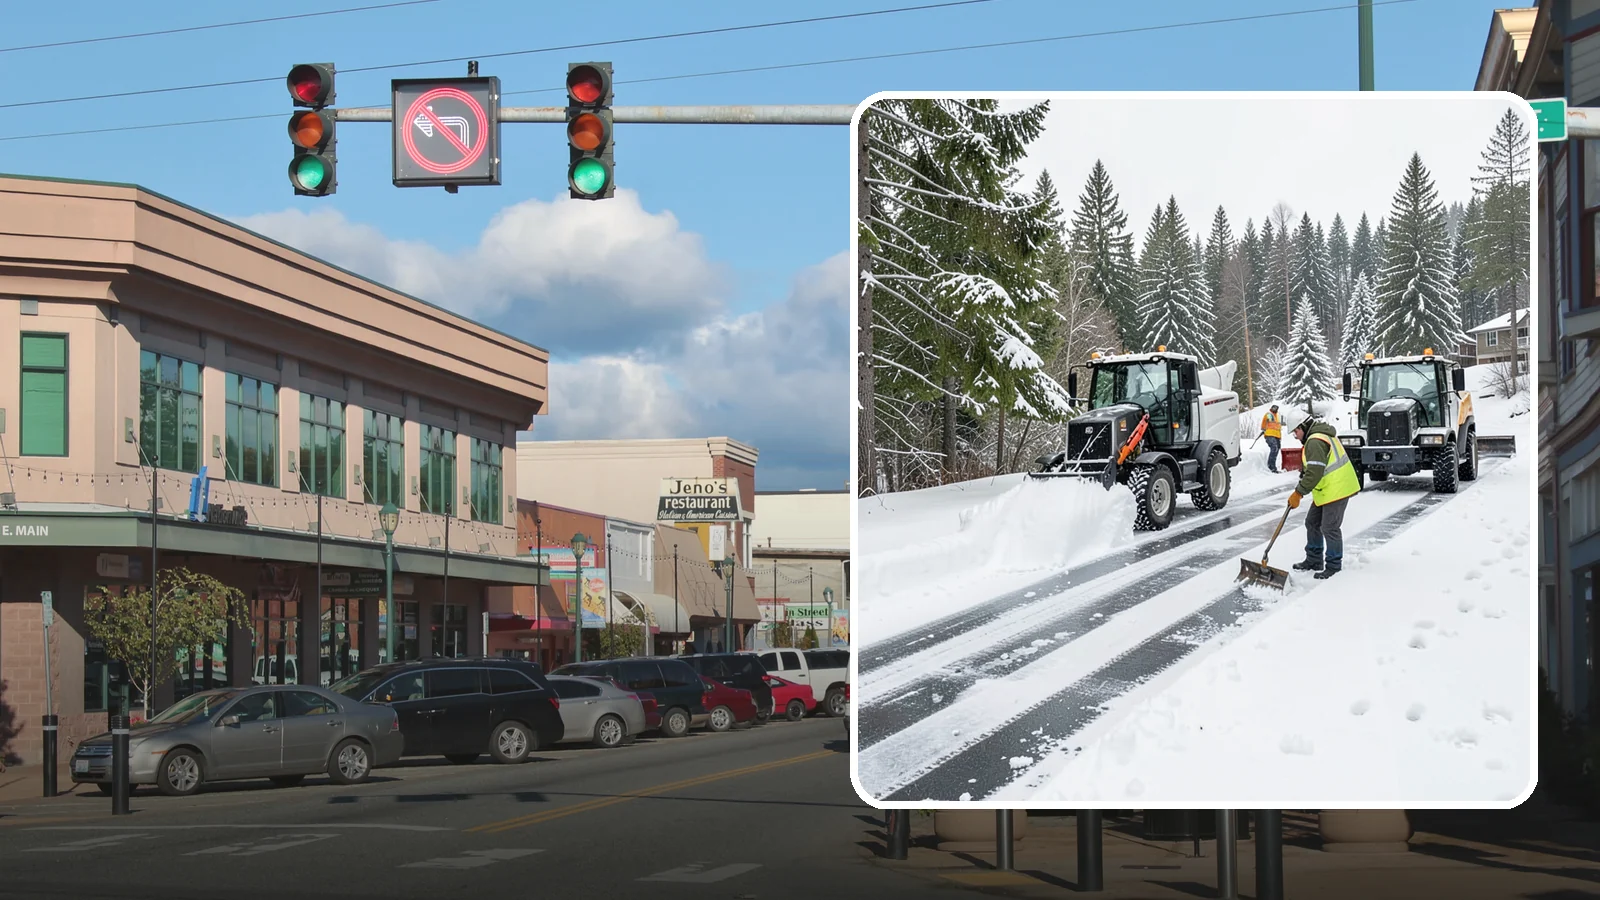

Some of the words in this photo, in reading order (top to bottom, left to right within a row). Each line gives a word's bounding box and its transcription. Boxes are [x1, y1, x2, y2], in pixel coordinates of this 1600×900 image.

[670, 480, 727, 493] Jeno's
[666, 496, 730, 508] restaurant
[659, 510, 681, 519] Italian
[685, 510, 714, 519] American
[715, 509, 737, 519] Cuisine
[2, 525, 13, 536] E.
[16, 525, 49, 536] MAIN
[786, 608, 794, 616] in
[797, 608, 828, 616] Street
[790, 619, 823, 627] lass
